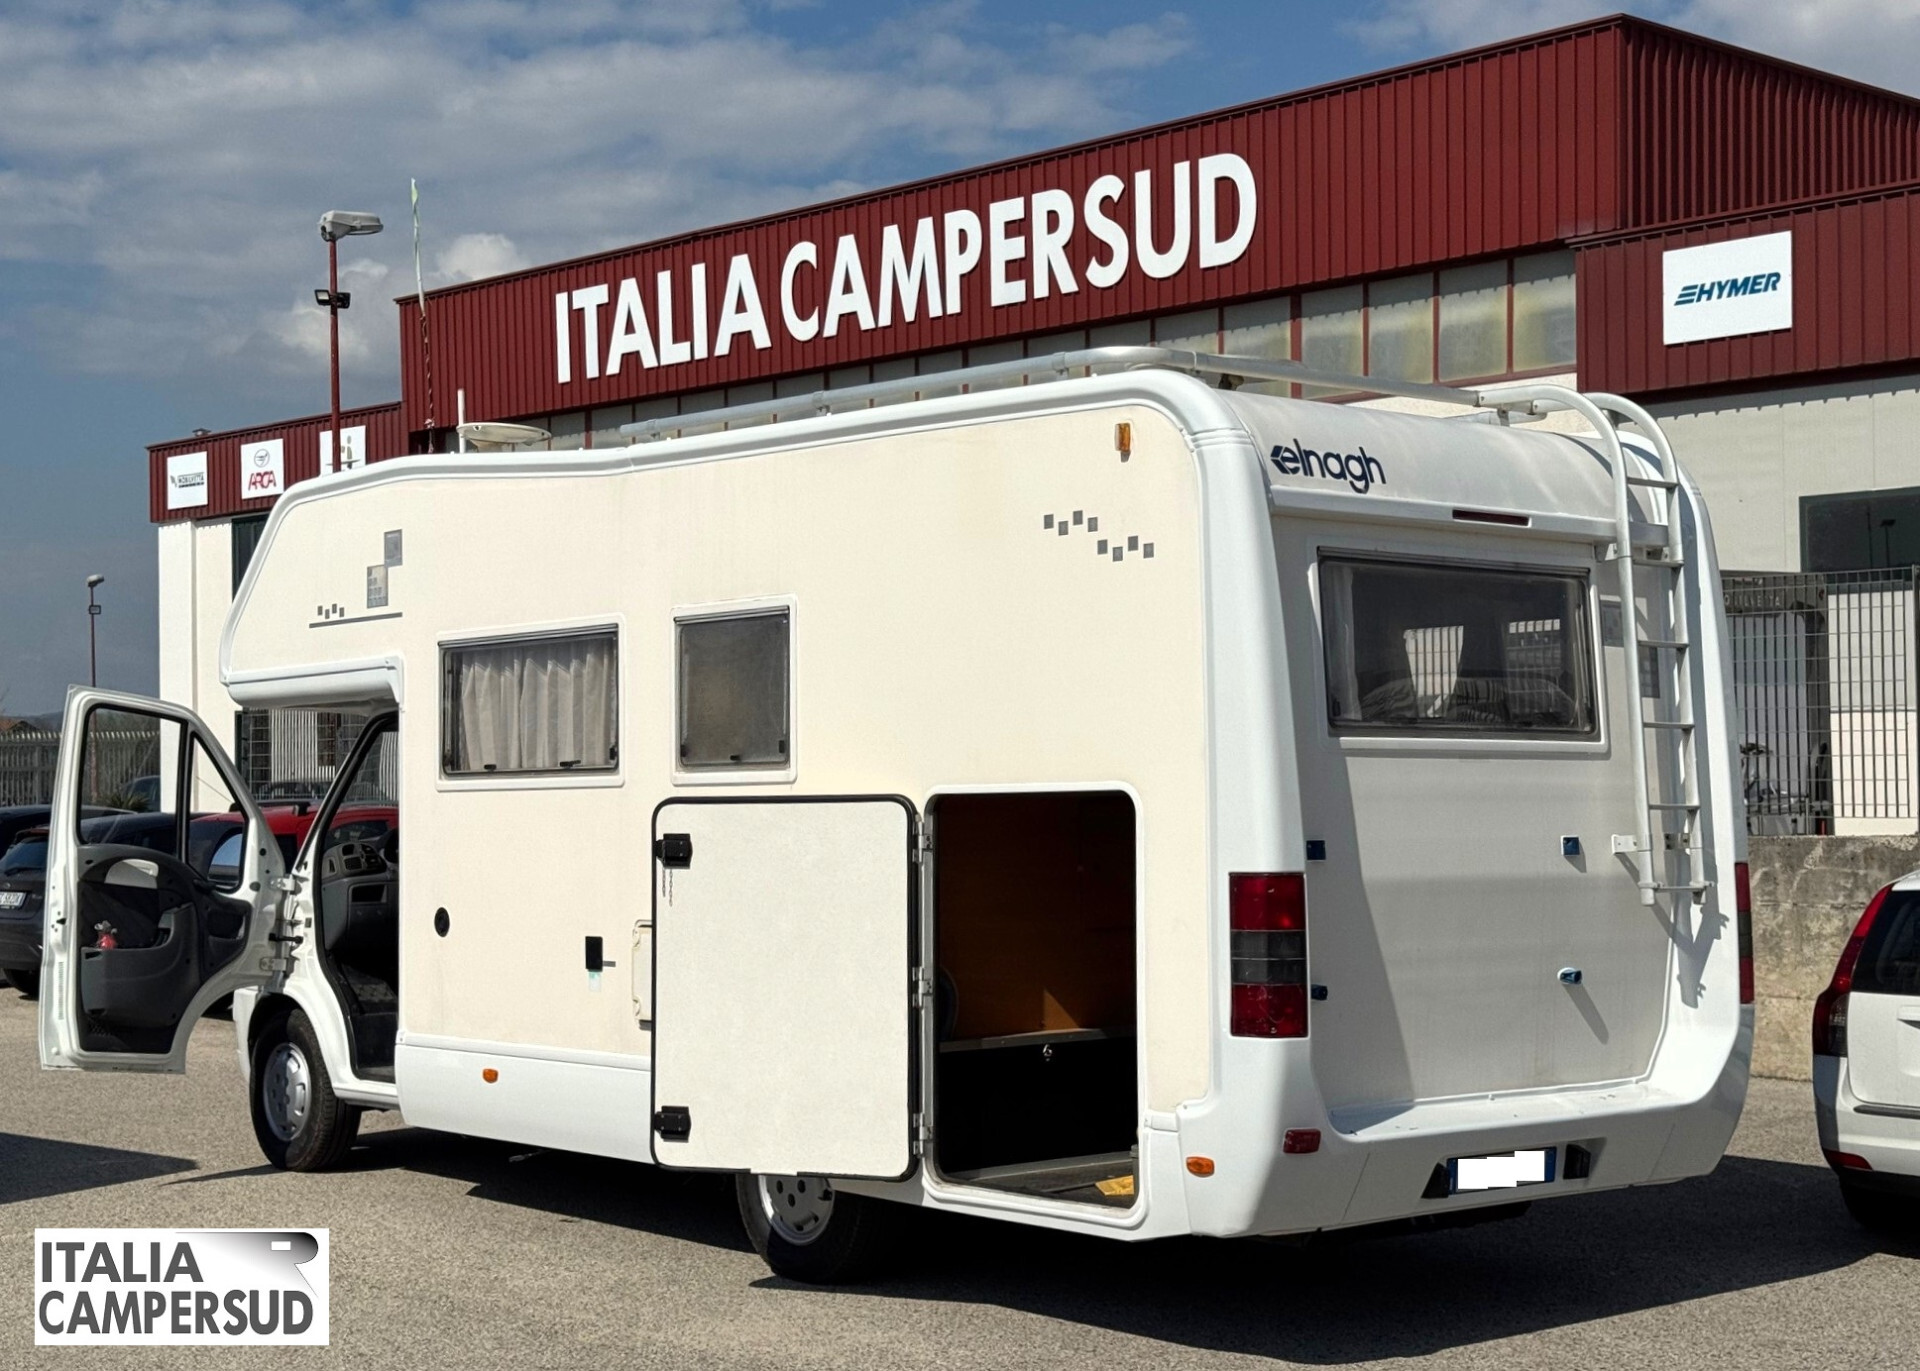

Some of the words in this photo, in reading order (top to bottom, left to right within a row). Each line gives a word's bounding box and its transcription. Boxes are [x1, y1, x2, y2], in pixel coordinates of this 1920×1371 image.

[555, 254, 772, 384] ITALIA
[781, 153, 1257, 342] CAMPERSUD
[1695, 271, 1782, 303] HYMER
[248, 470, 277, 491] ARCA
[1270, 438, 1387, 494] elnagh
